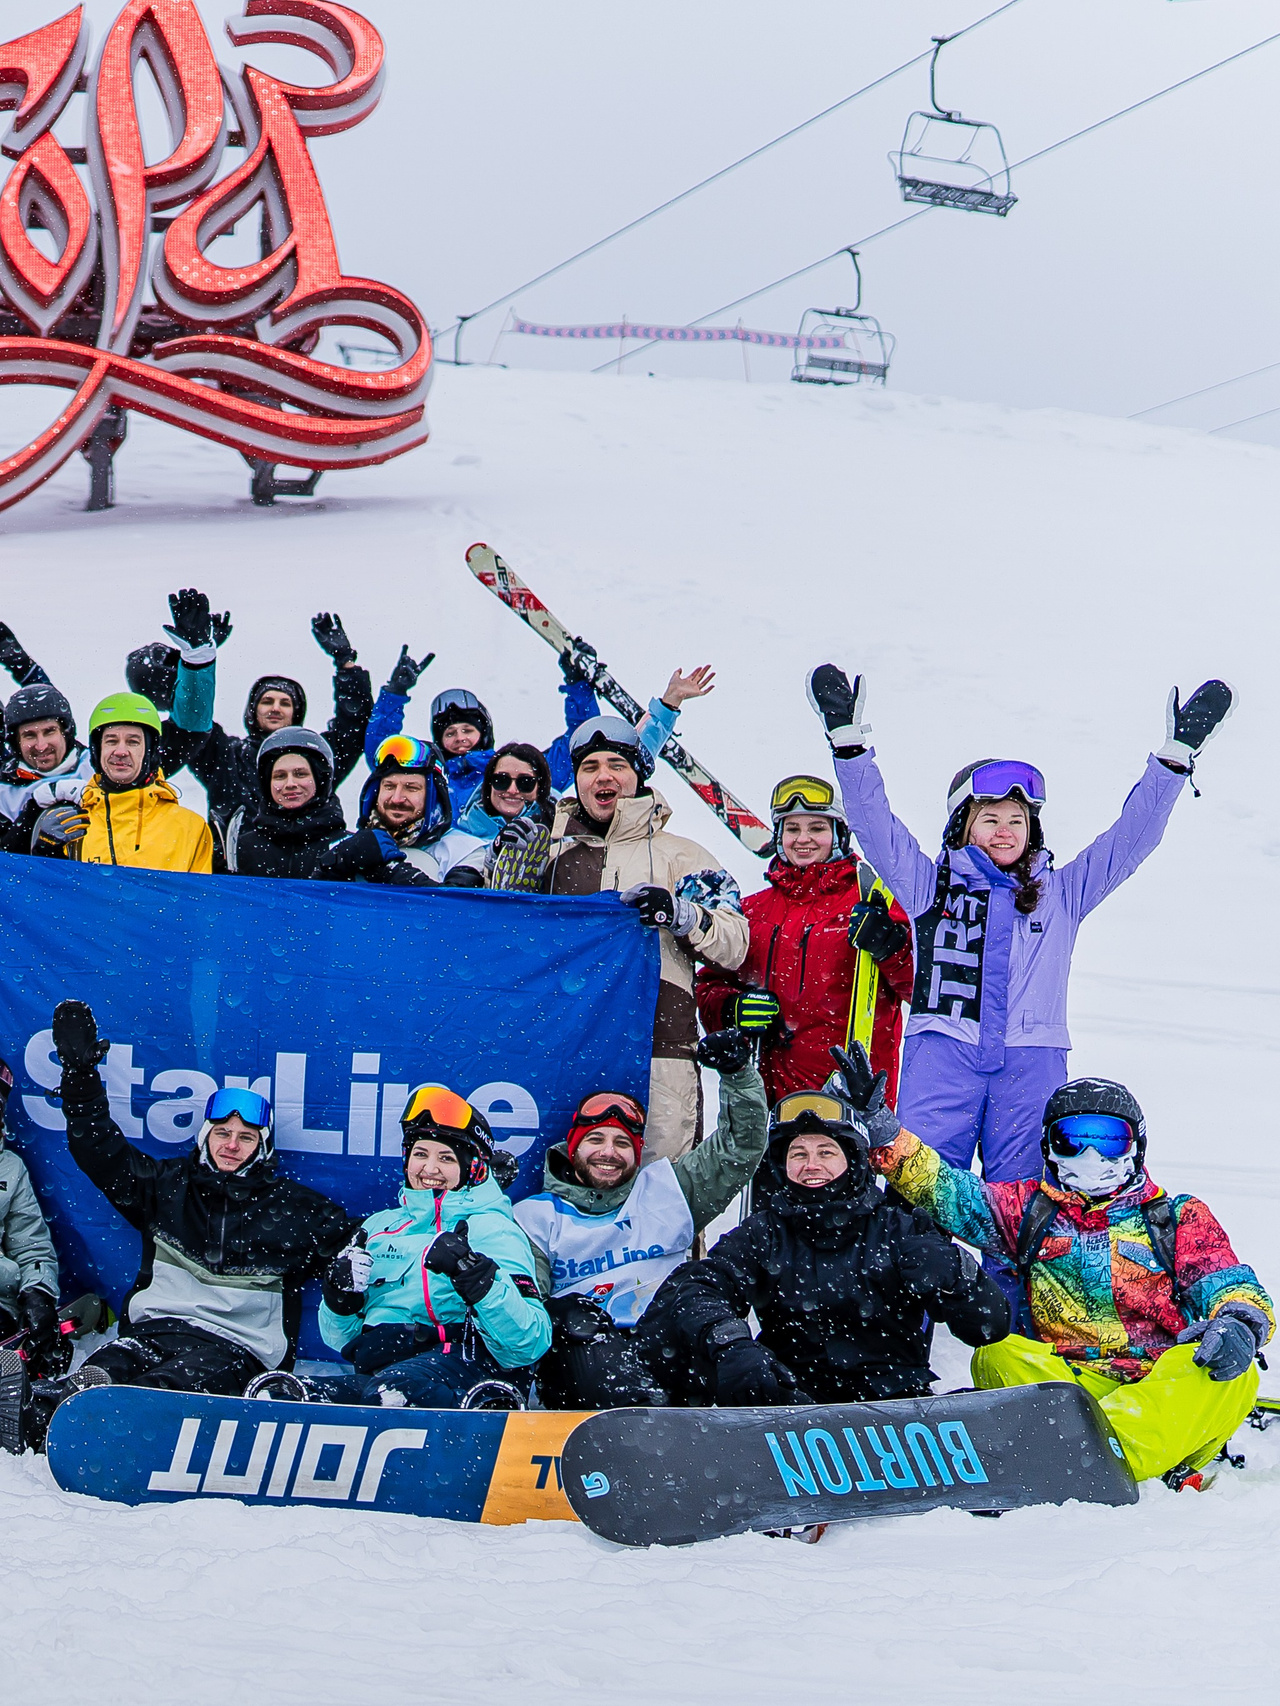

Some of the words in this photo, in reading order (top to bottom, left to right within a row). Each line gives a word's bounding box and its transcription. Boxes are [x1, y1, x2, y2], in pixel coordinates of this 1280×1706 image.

[551, 1244, 665, 1280] StarLine
[147, 1417, 428, 1502] JOINT
[764, 1420, 989, 1498] BURTON
